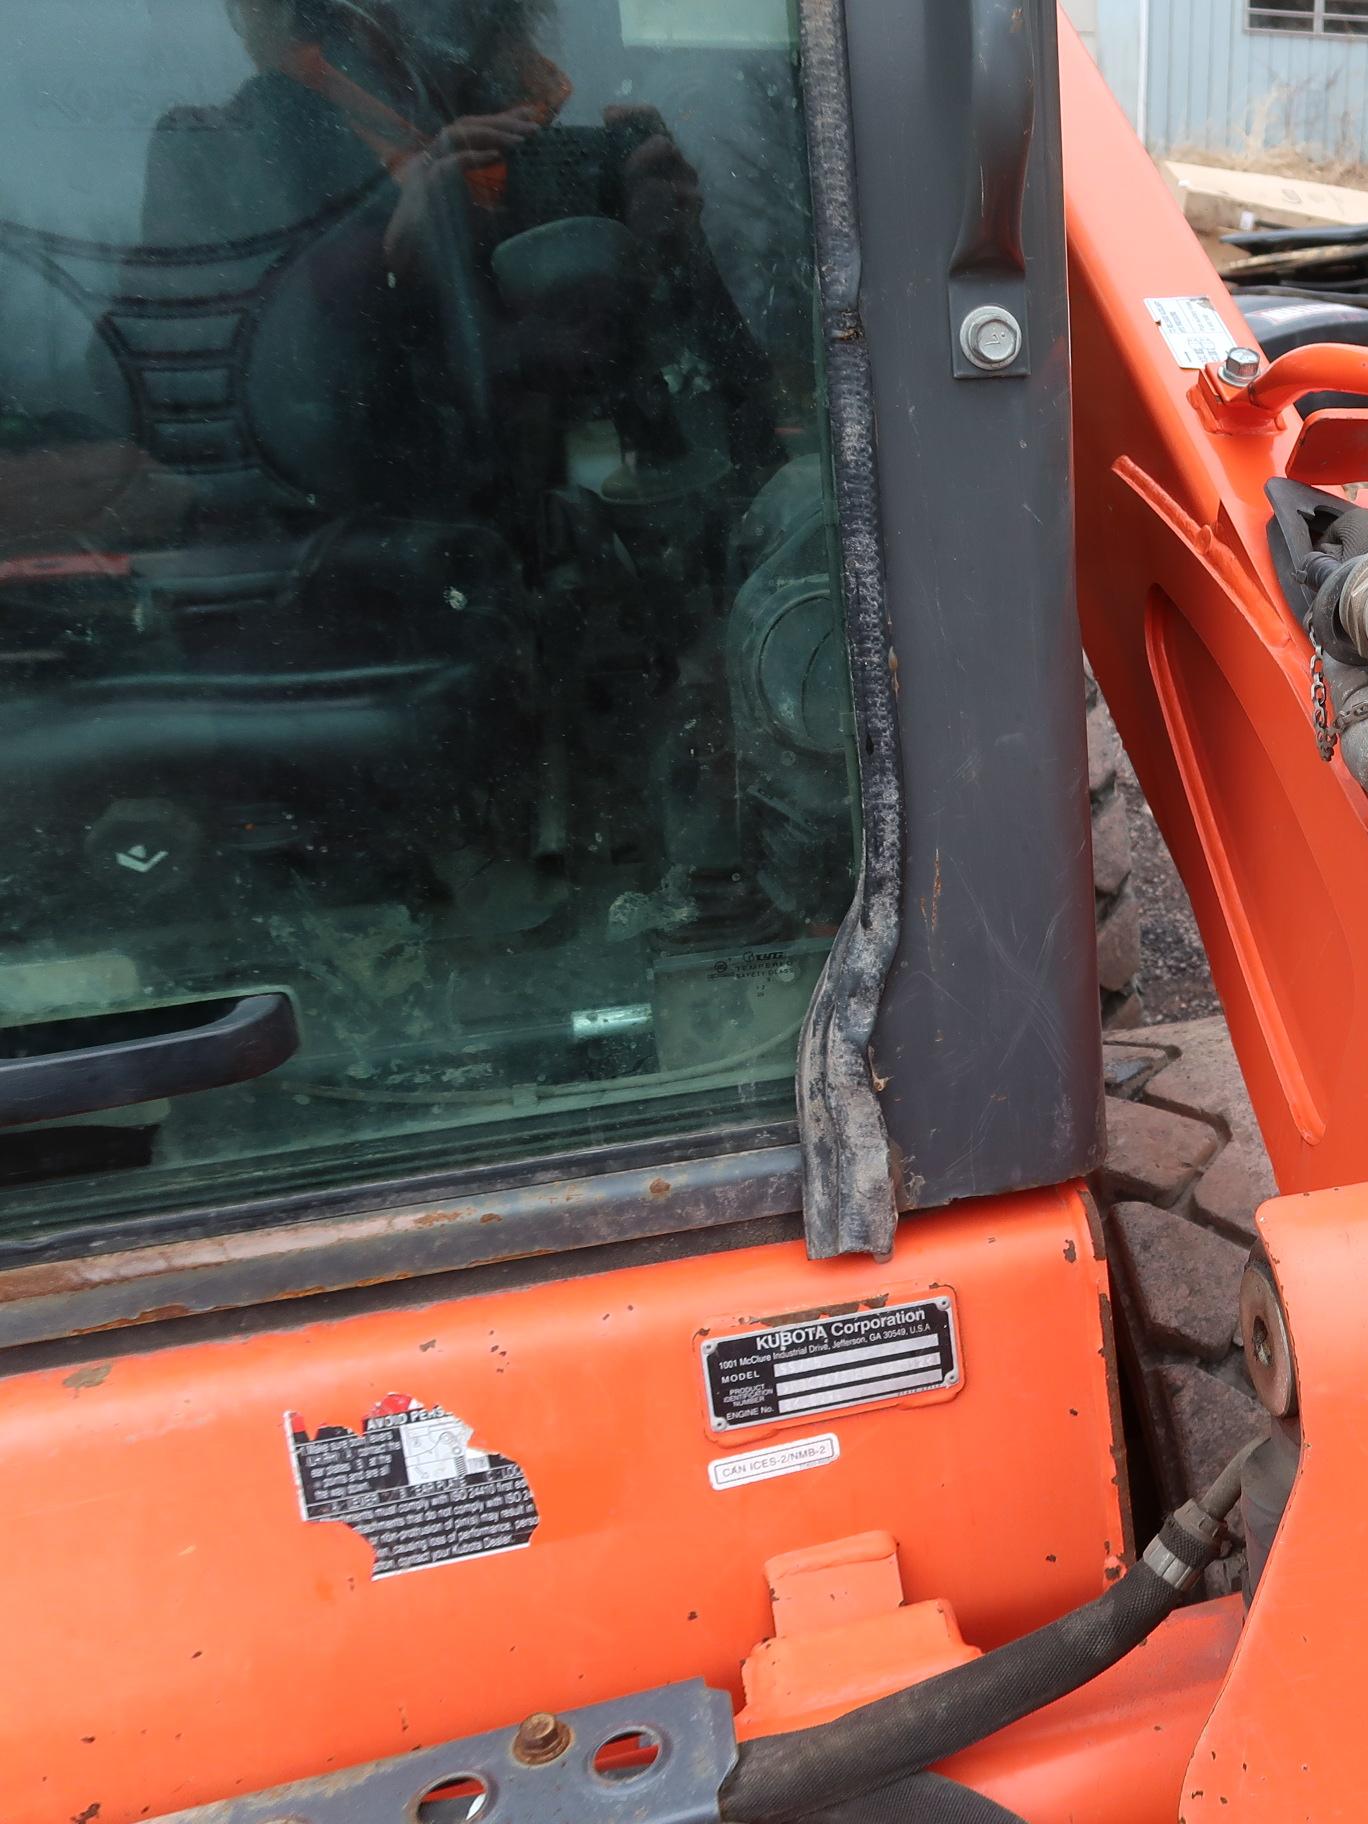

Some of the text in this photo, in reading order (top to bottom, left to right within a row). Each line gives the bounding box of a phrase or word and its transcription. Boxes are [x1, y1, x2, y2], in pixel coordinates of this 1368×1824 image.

[756, 1309, 925, 1350] KUBOTA Corporation
[719, 1359, 737, 1370] 1001
[739, 1353, 772, 1366] McClure
[773, 1346, 808, 1360] Industrial
[832, 1336, 868, 1349] Jefferson,
[869, 1332, 882, 1342] GA
[721, 1370, 760, 1384] MODEL
[723, 1389, 773, 1403] IDENTIFICATION
[729, 1383, 765, 1396] PRODUCT
[732, 1396, 765, 1407] NUMBER
[726, 1405, 775, 1421] ENGINE No.
[366, 1413, 408, 1431] AVOID
[722, 1464, 747, 1477] CAN
[749, 1445, 826, 1471] ICES-2/NMB-2
